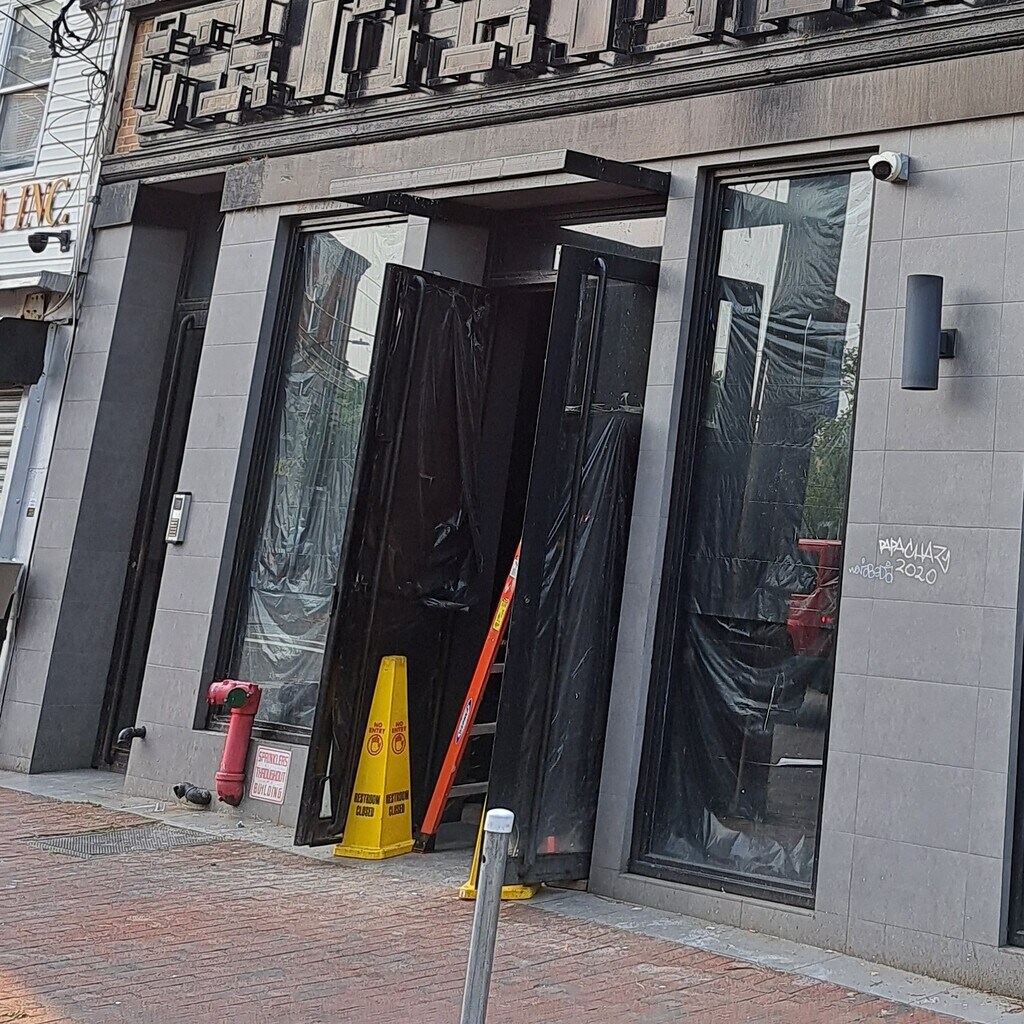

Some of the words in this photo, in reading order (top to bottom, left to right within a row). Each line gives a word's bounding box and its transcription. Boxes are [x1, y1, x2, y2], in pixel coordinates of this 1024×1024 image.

[895, 558, 938, 585] 2020
[253, 782, 283, 799] BUILDING
[385, 790, 409, 804] RESTROOM
[354, 792, 381, 805] RESTROOM
[355, 805, 375, 817] CLOSED
[388, 803, 405, 816] CLOSED
